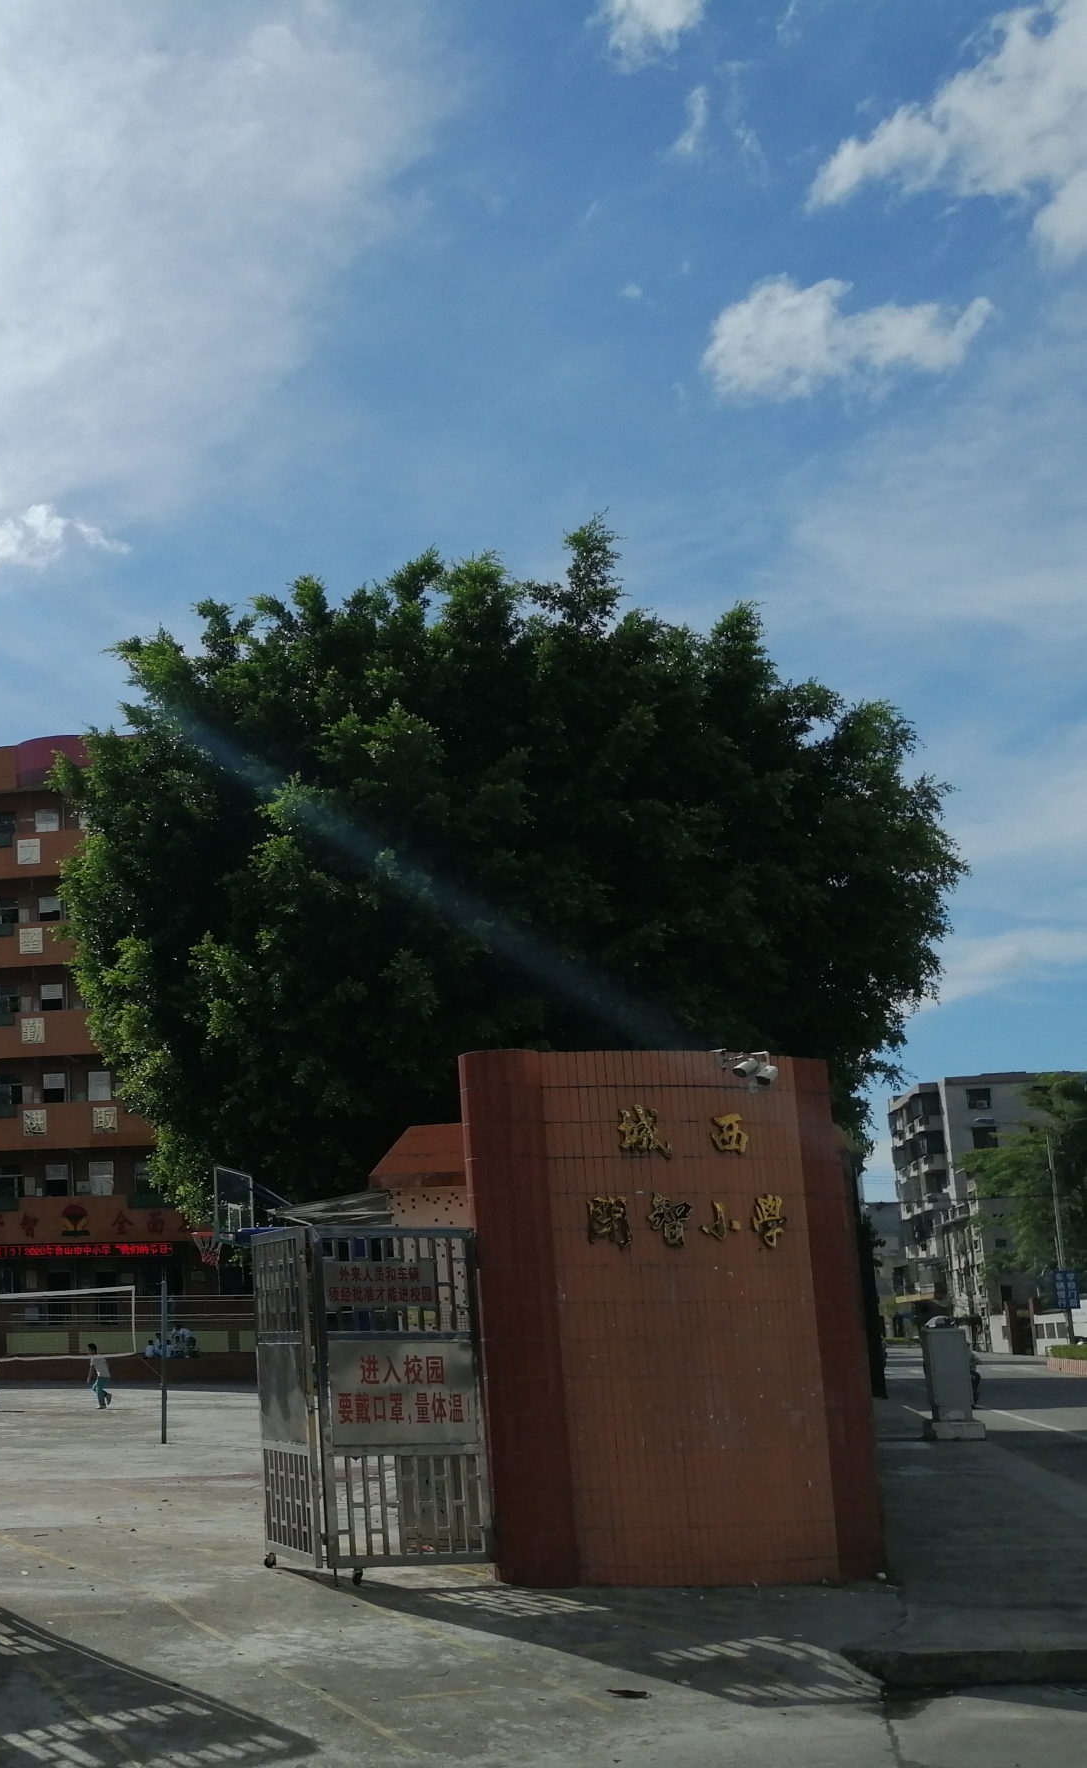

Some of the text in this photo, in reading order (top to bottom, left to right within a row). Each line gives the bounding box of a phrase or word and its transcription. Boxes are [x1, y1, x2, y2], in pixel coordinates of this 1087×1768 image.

[339, 1266, 420, 1283] 外来人员和车辆
[328, 1286, 432, 1303] 须经批准才能进校园
[360, 1355, 444, 1385] 进入校园
